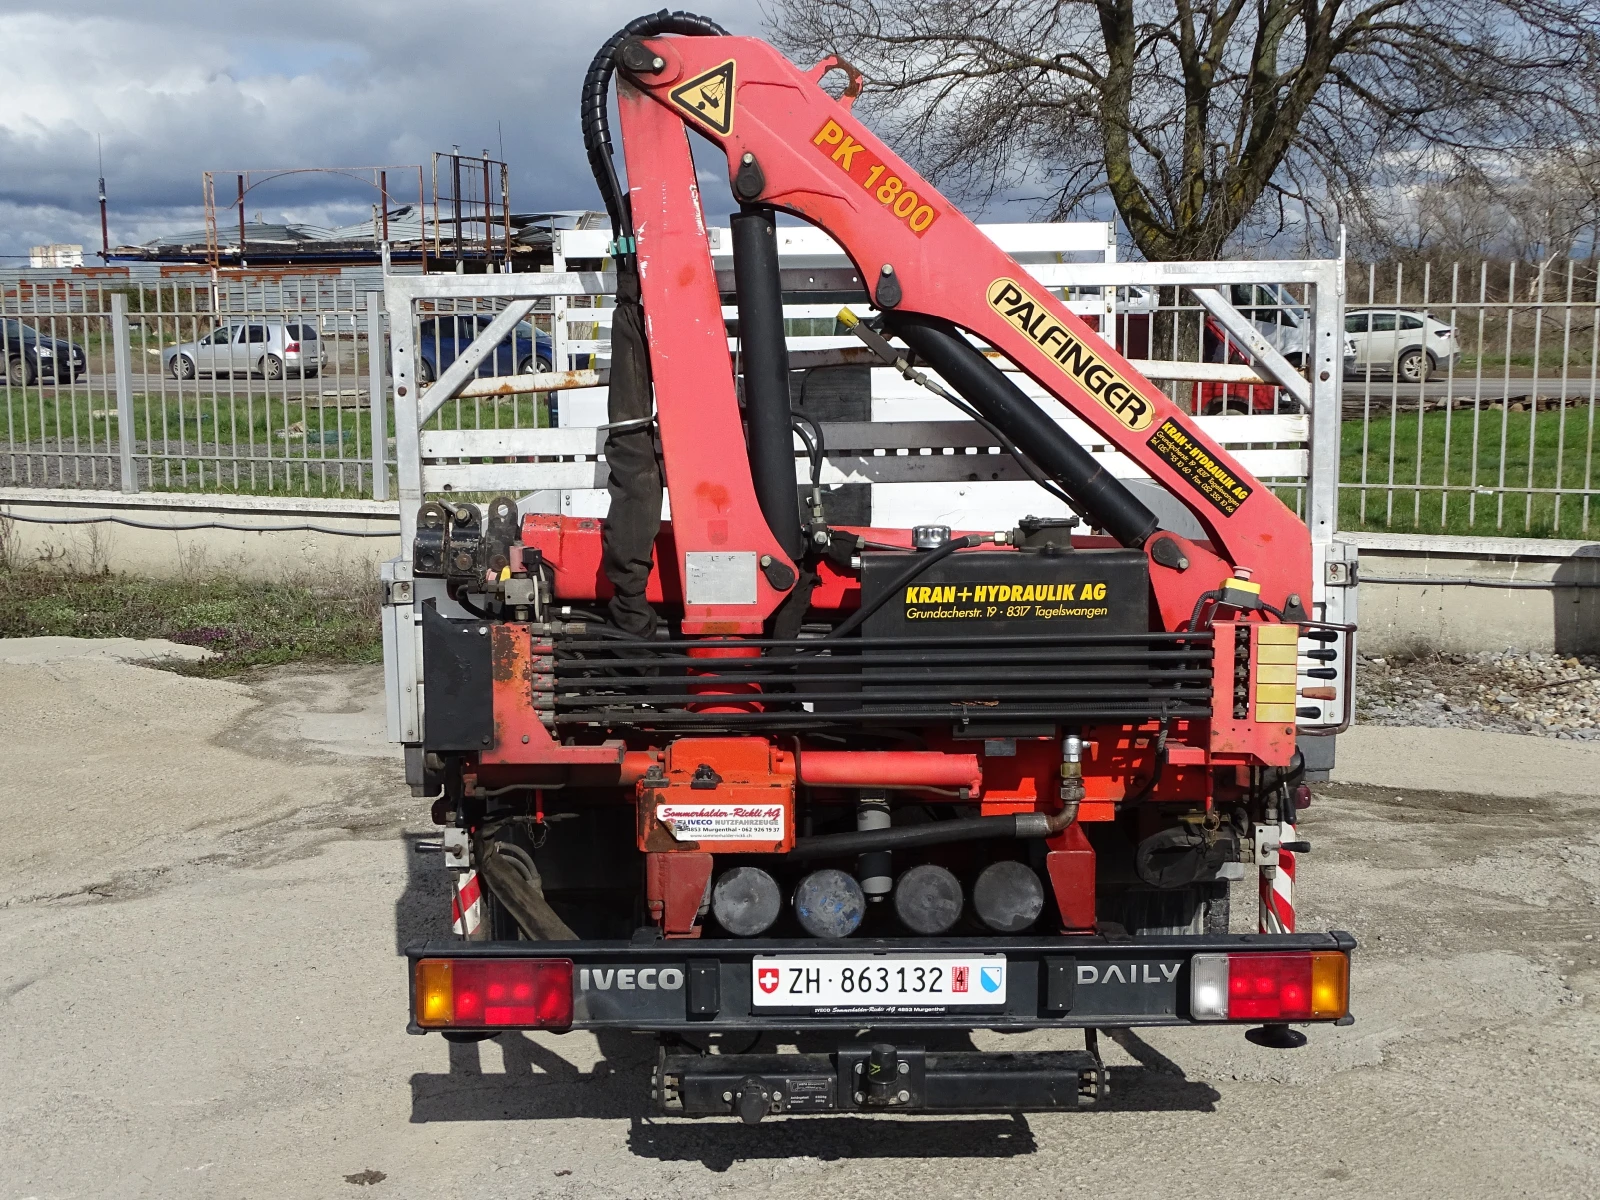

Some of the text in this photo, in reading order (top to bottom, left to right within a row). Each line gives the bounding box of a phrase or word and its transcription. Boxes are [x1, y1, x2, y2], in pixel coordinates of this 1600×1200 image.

[813, 119, 934, 232] PK 1800
[993, 283, 1147, 427] PALFINGER
[1161, 421, 1248, 499] KRAN+HYDRAULIK AG
[1189, 458, 1196, 466] 19
[1176, 460, 1184, 468] 10
[1182, 466, 1191, 474] 60
[1192, 475, 1202, 485] Fax
[1201, 483, 1212, 493] 052
[1210, 490, 1222, 501] 355
[1226, 505, 1235, 513] 66
[905, 583, 1106, 603] KRAN+HYDRAULIK AG
[907, 604, 1107, 619] Grundacherstr. 19 8317 Tagelswangen
[762, 808, 781, 821] AG
[580, 968, 684, 990] IVECO
[789, 968, 820, 994] ZH
[841, 967, 943, 993] 863132
[1077, 963, 1181, 985] DAILY
[886, 1006, 896, 1014] AG
